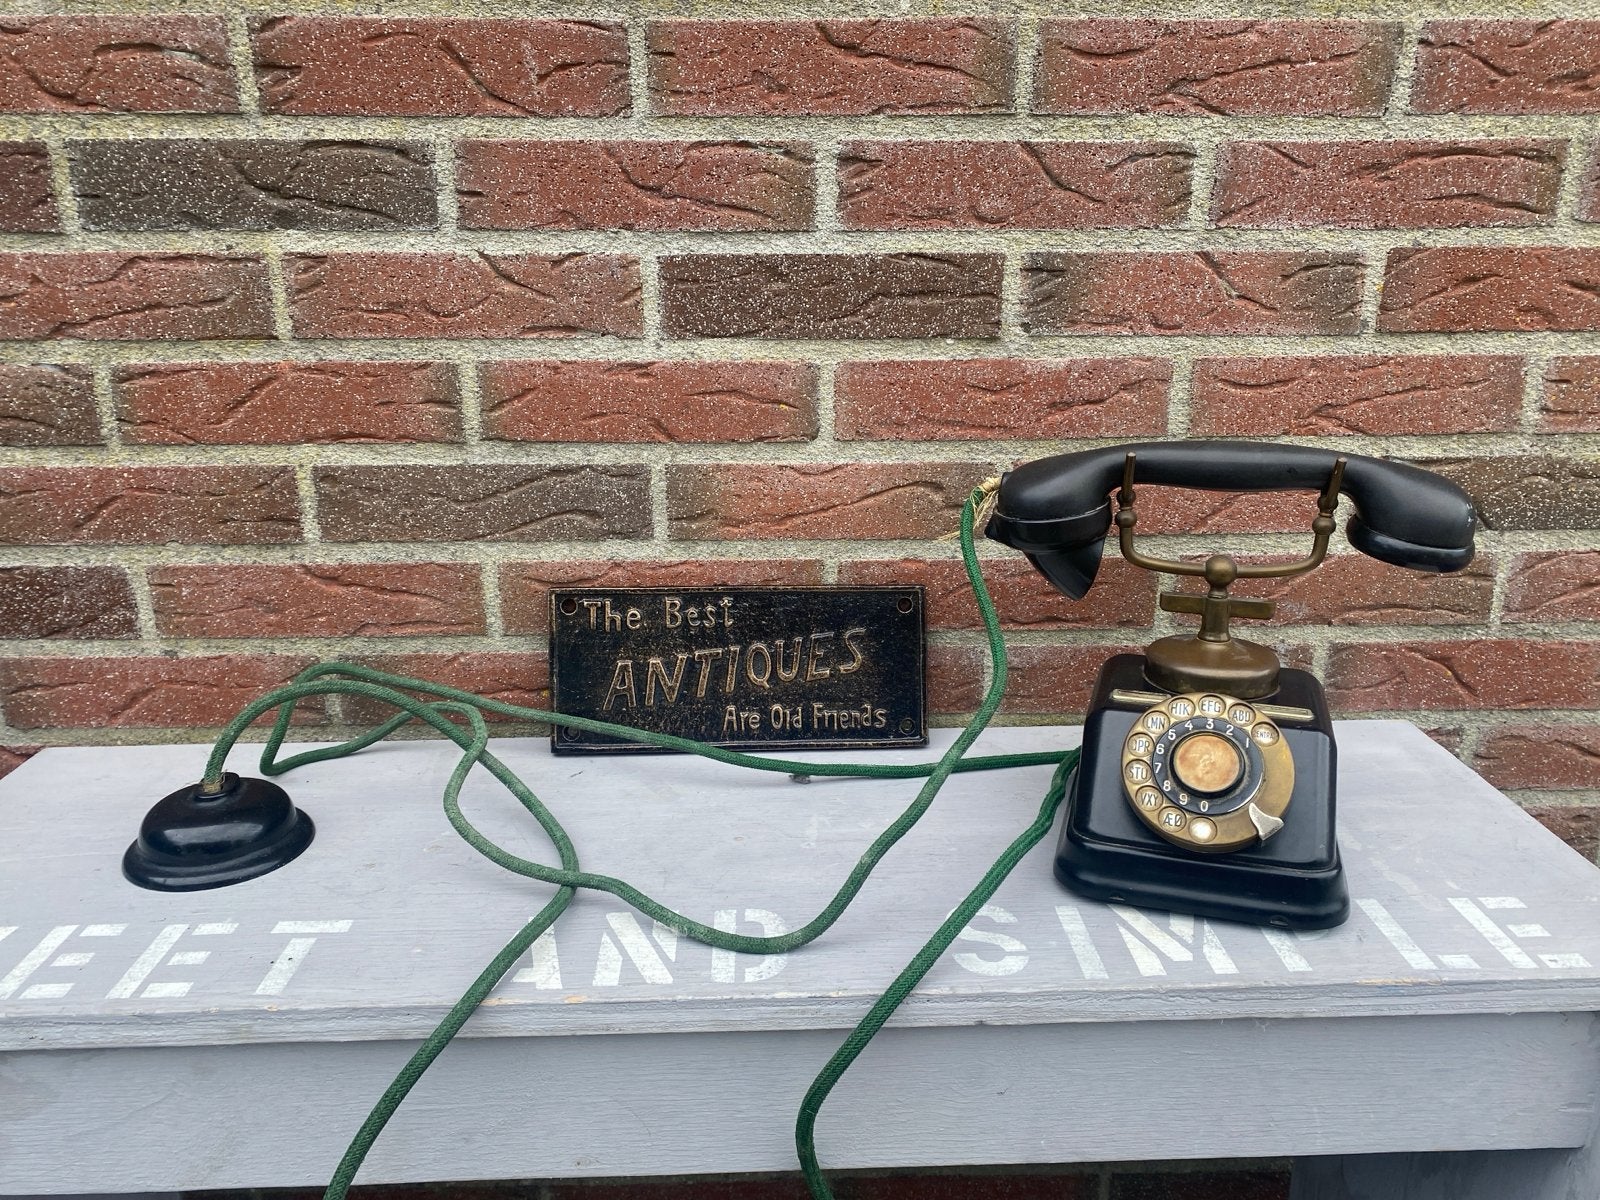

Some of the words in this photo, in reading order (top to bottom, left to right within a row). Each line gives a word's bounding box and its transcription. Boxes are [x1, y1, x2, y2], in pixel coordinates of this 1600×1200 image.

[583, 599, 643, 633] The
[664, 596, 735, 629] Best
[602, 627, 867, 711] ANTIQUES
[1170, 702, 1190, 715] HIK
[1201, 700, 1221, 713] EFG
[721, 704, 761, 733] Are
[769, 703, 802, 730] Old
[812, 702, 887, 731] Friends
[1184, 720, 1193, 731] 4
[1206, 719, 1214, 730] 3
[1226, 724, 1235, 736] 2
[1167, 729, 1177, 741] 5
[1156, 743, 1165, 754] 6
[1245, 737, 1250, 748] 1
[1129, 766, 1149, 780] STU
[1155, 762, 1162, 773] 7
[1163, 780, 1171, 792] 8
[1179, 793, 1188, 805] 9
[1200, 800, 1209, 812] 0
[0, 919, 354, 1000] EET
[491, 909, 790, 991] AND
